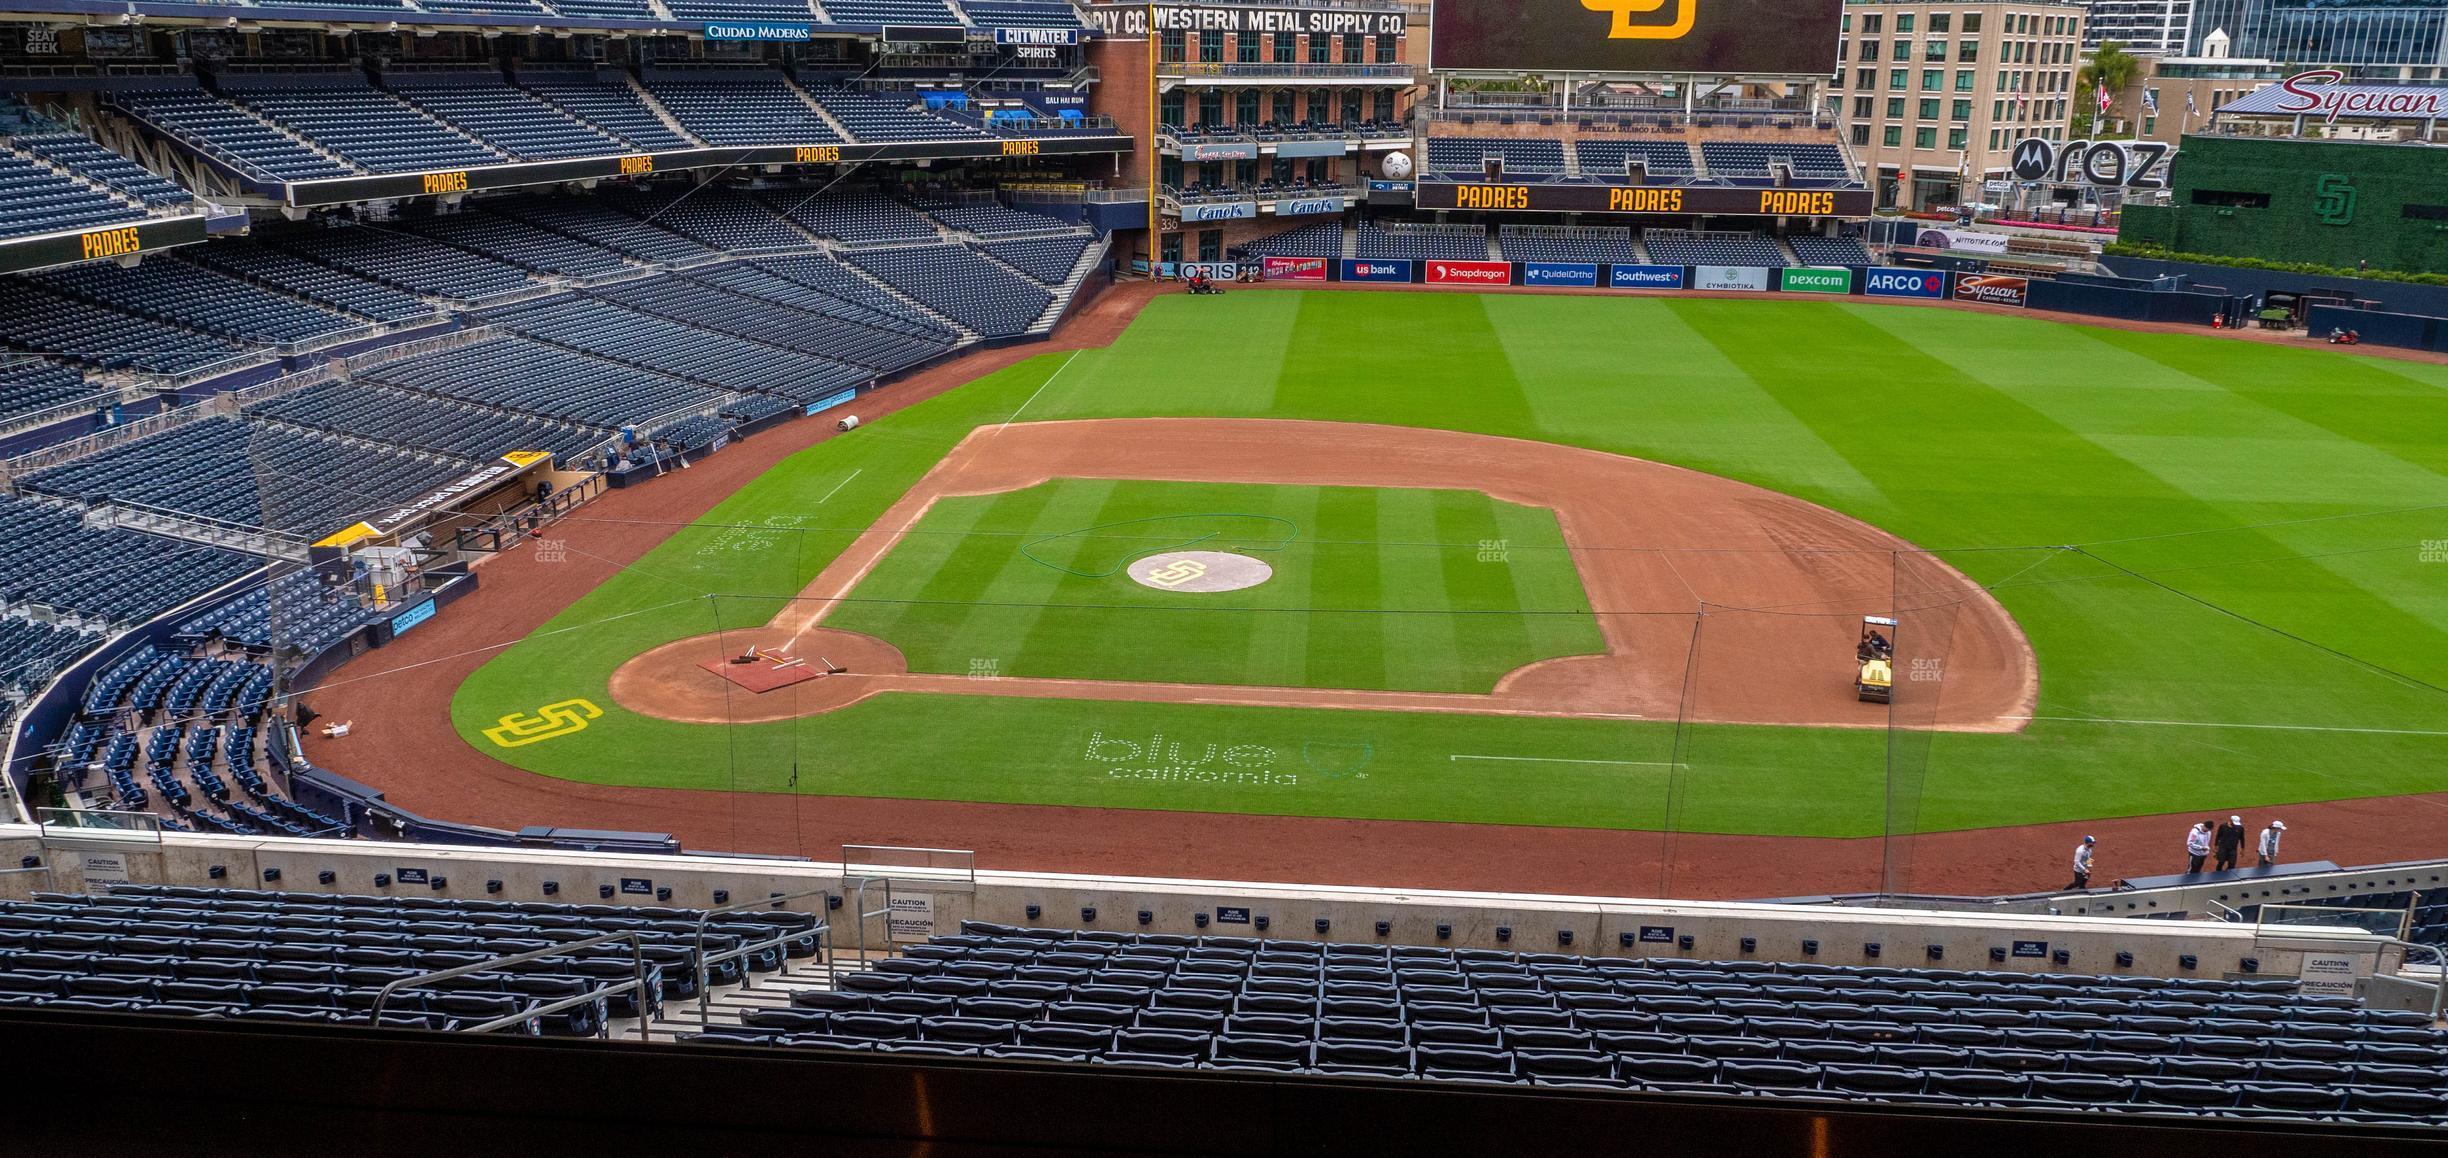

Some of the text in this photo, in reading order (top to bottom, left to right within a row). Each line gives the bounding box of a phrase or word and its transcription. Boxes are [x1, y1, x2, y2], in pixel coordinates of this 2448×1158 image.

[1125, 10, 1149, 34] CO.
[1153, 8, 1405, 34] WESTERN METAL SUPPLY CO.
[708, 25, 808, 39] CIUDAD MADERAS
[1005, 29, 1069, 44] CUTWATER
[1017, 47, 1056, 59] SPIRITS
[1045, 96, 1059, 104] BALI
[2277, 70, 2443, 124] Sycuan
[797, 146, 839, 162] PADRES
[1002, 141, 1039, 155] PADRES
[619, 155, 652, 174] PADRES
[424, 171, 467, 194] PADRES
[1456, 185, 1528, 209] PADRES
[1609, 188, 1682, 211] PADRES
[1760, 190, 1833, 214] PADRES
[1196, 204, 1243, 221] Canel's
[1289, 199, 1333, 215] Canel's
[1161, 218, 1178, 231] 336
[82, 226, 140, 258] PADRES
[1183, 264, 1234, 279] ORIS
[1356, 264, 1396, 274] us bank
[1450, 267, 1505, 280] Snapdragon
[1541, 269, 1594, 280] QuidelOrtho
[1615, 271, 1671, 283] Southwest
[1705, 282, 1754, 290] CYMBIOTIKA
[1868, 275, 1922, 291] ARCO
[1958, 276, 2018, 300] Sycuan
[393, 613, 414, 631] petco
[1085, 731, 1277, 767] blue
[1109, 766, 1297, 785] california
[87, 858, 119, 866] CAUTION
[2311, 959, 2350, 967] CAUTION
